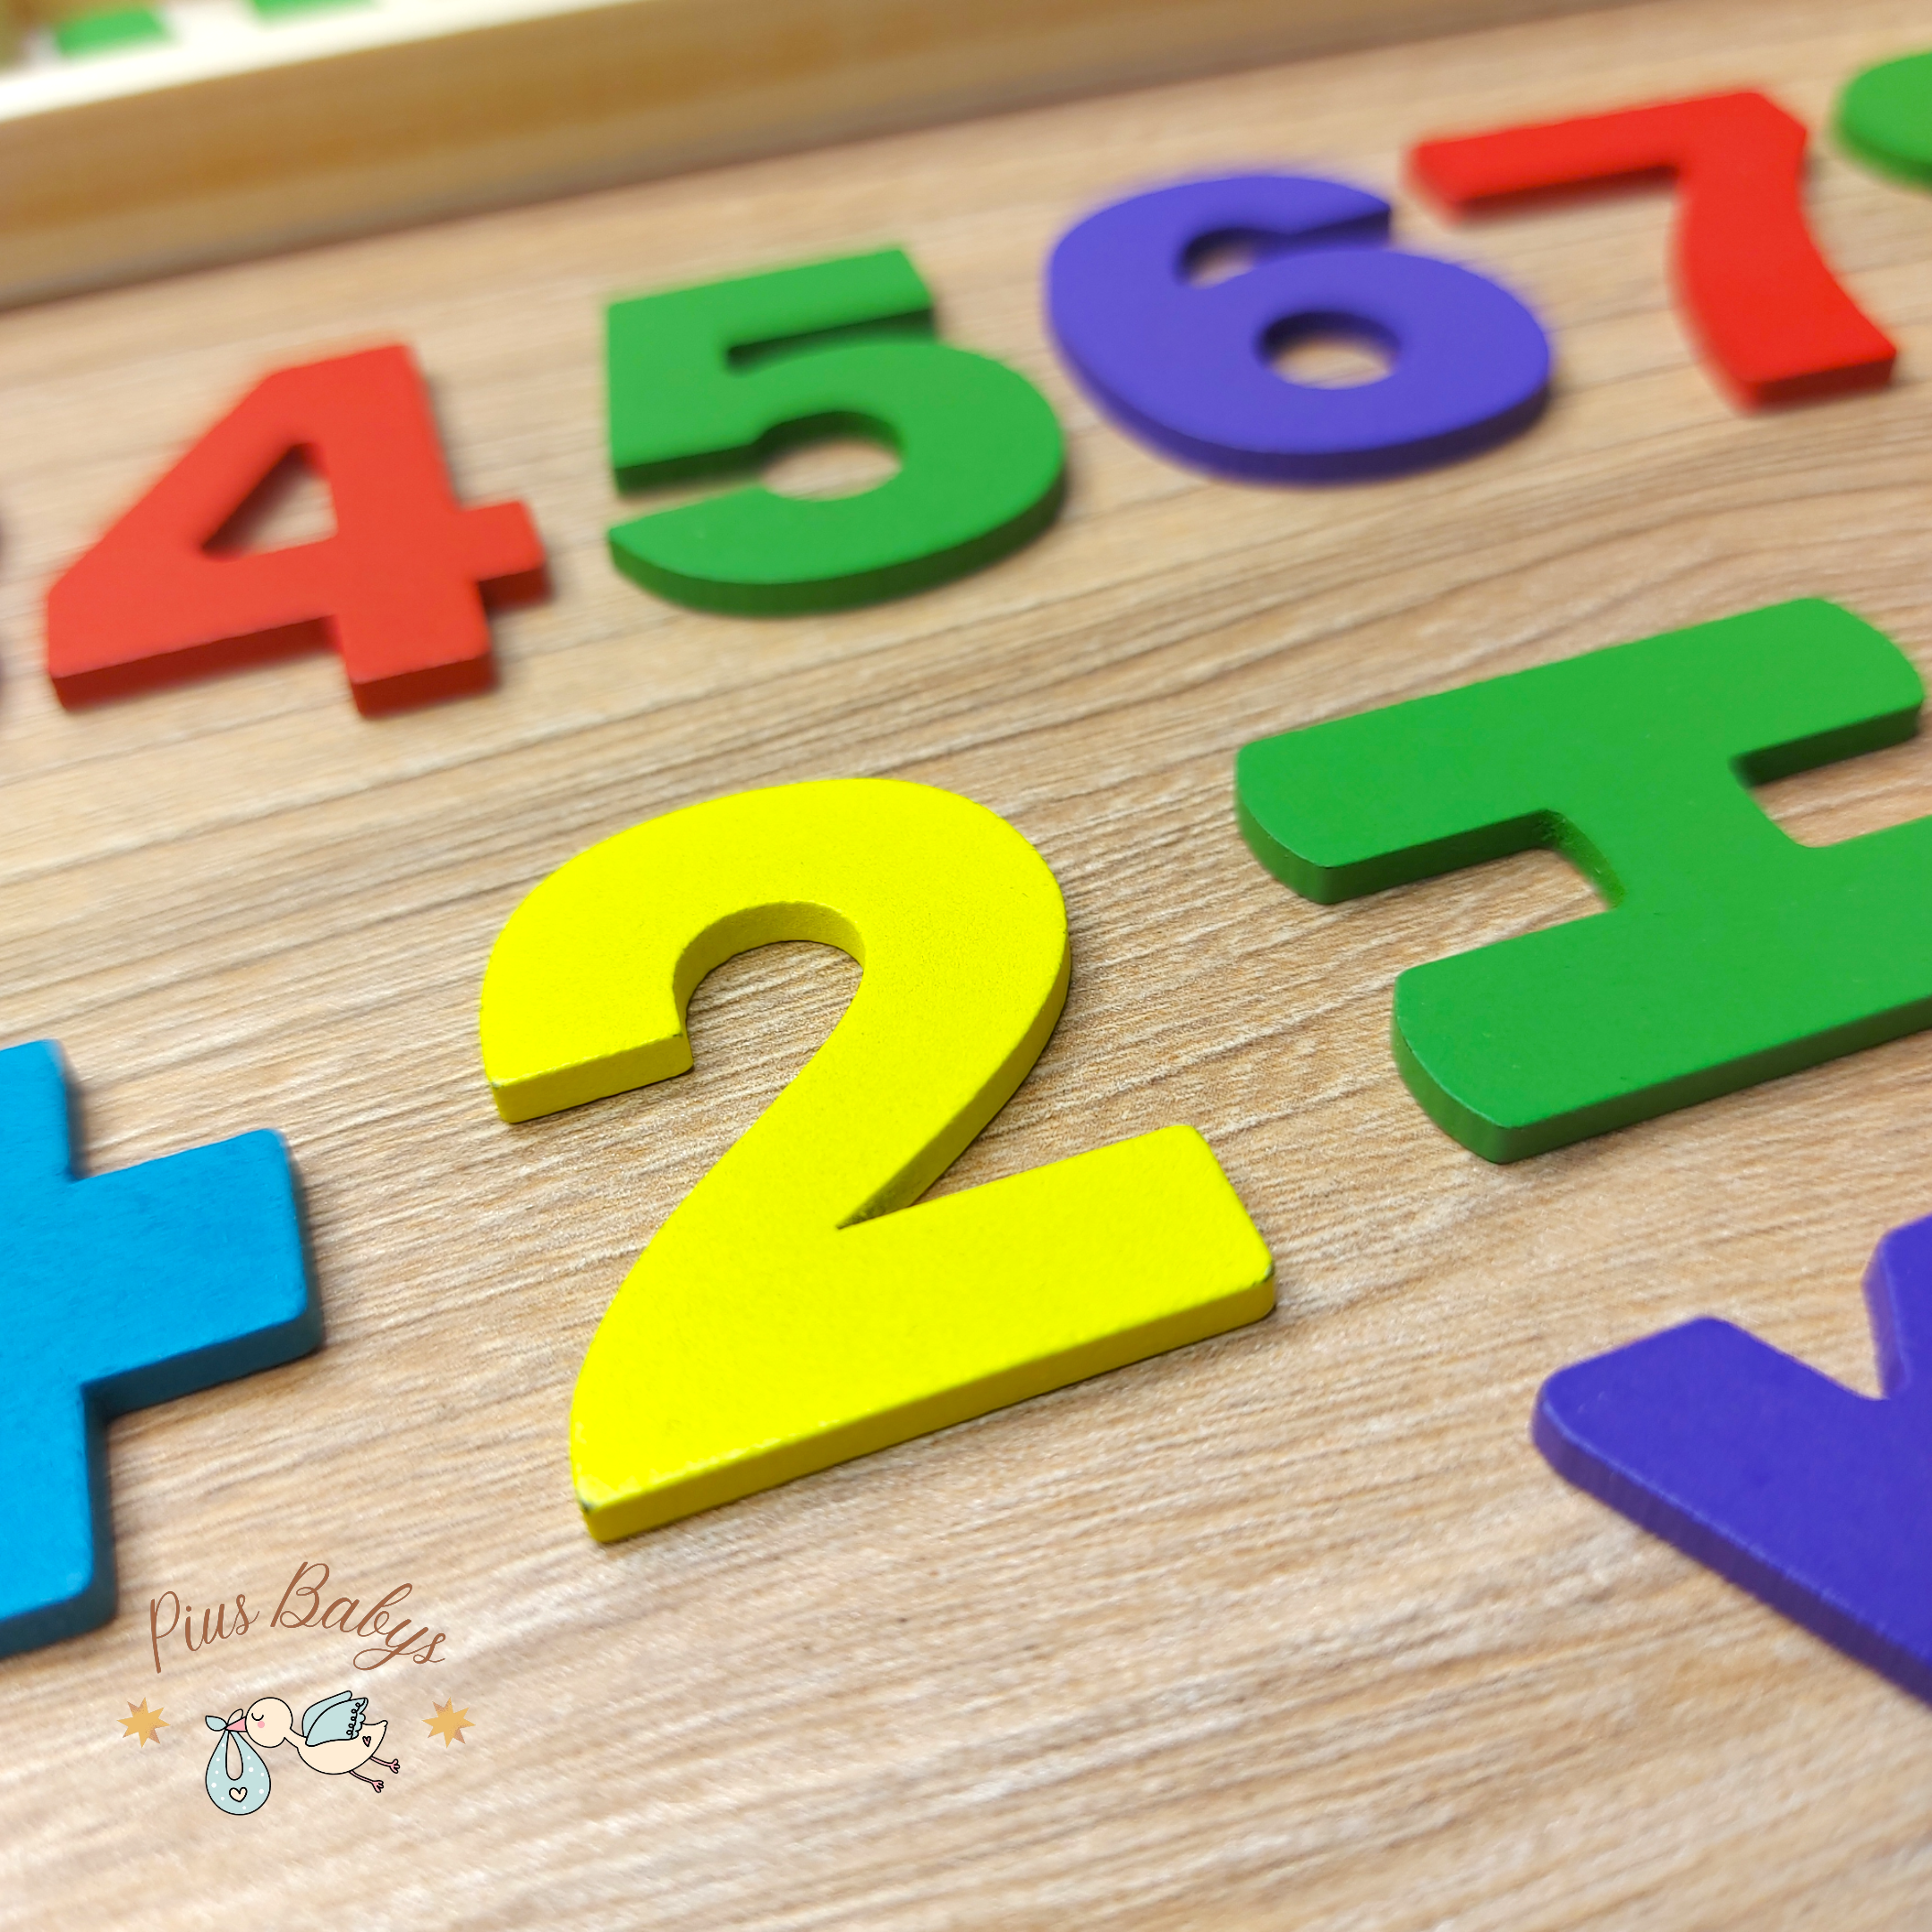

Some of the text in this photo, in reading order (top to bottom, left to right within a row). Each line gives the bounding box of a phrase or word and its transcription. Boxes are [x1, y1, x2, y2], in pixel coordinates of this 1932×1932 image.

[47, 342, 549, 718] 4
[605, 248, 1067, 617] 5
[1046, 168, 1553, 483] 6
[1406, 89, 1896, 410] 7
[479, 777, 1277, 1543] 2
